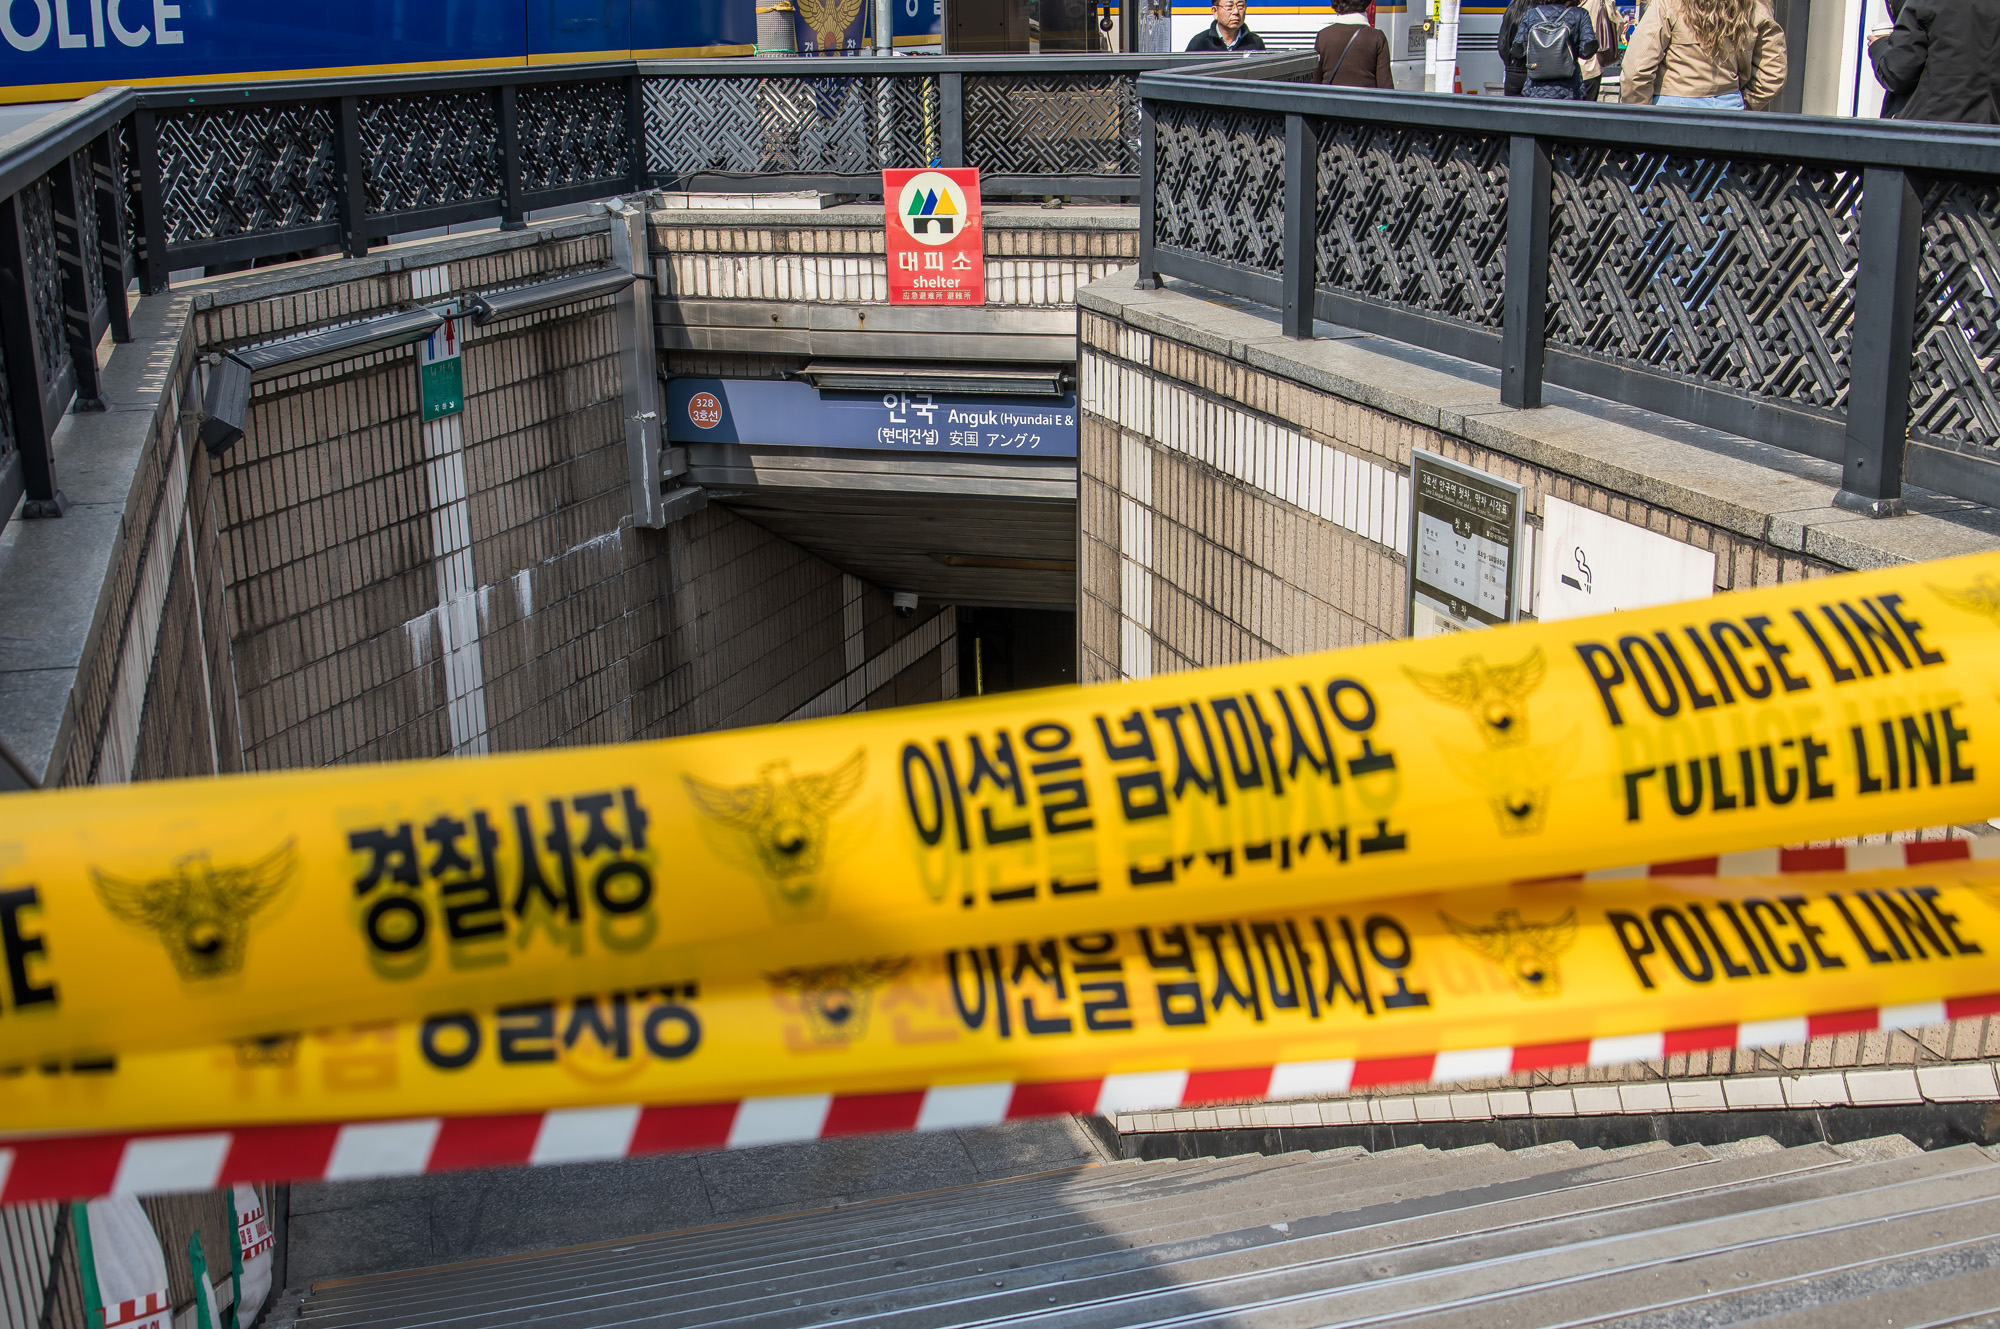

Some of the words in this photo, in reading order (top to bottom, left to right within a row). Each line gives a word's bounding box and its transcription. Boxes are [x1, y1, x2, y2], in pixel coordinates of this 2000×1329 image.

[0, 0, 185, 52] OLICE
[898, 251, 972, 272] 대피소
[913, 275, 961, 288] shelter
[696, 398, 714, 408] 328
[883, 392, 939, 424] 안국
[693, 410, 718, 422] 3호선
[948, 409, 998, 428] Anguk
[1000, 412, 1053, 426] (Hyundai
[1055, 415, 1062, 426] E
[1064, 415, 1074, 426] &
[877, 427, 939, 446] (현대건설)
[949, 430, 979, 447] 安国
[986, 433, 1041, 449] アングク
[1422, 474, 1437, 490] 3호선
[1439, 480, 1457, 497] 안국역
[1573, 613, 1811, 726] POLICE
[1790, 592, 1946, 684] LINE
[1850, 701, 1976, 794] LINE
[901, 721, 1094, 852] 이선을
[1095, 677, 1398, 822] 넘지마시오
[348, 785, 651, 953] 경찰서장
[1605, 893, 1847, 989] POLICE
[1824, 884, 1985, 964] LINE
[946, 928, 1133, 1038] 이선을
[1136, 912, 1432, 1027] 넘지마시오
